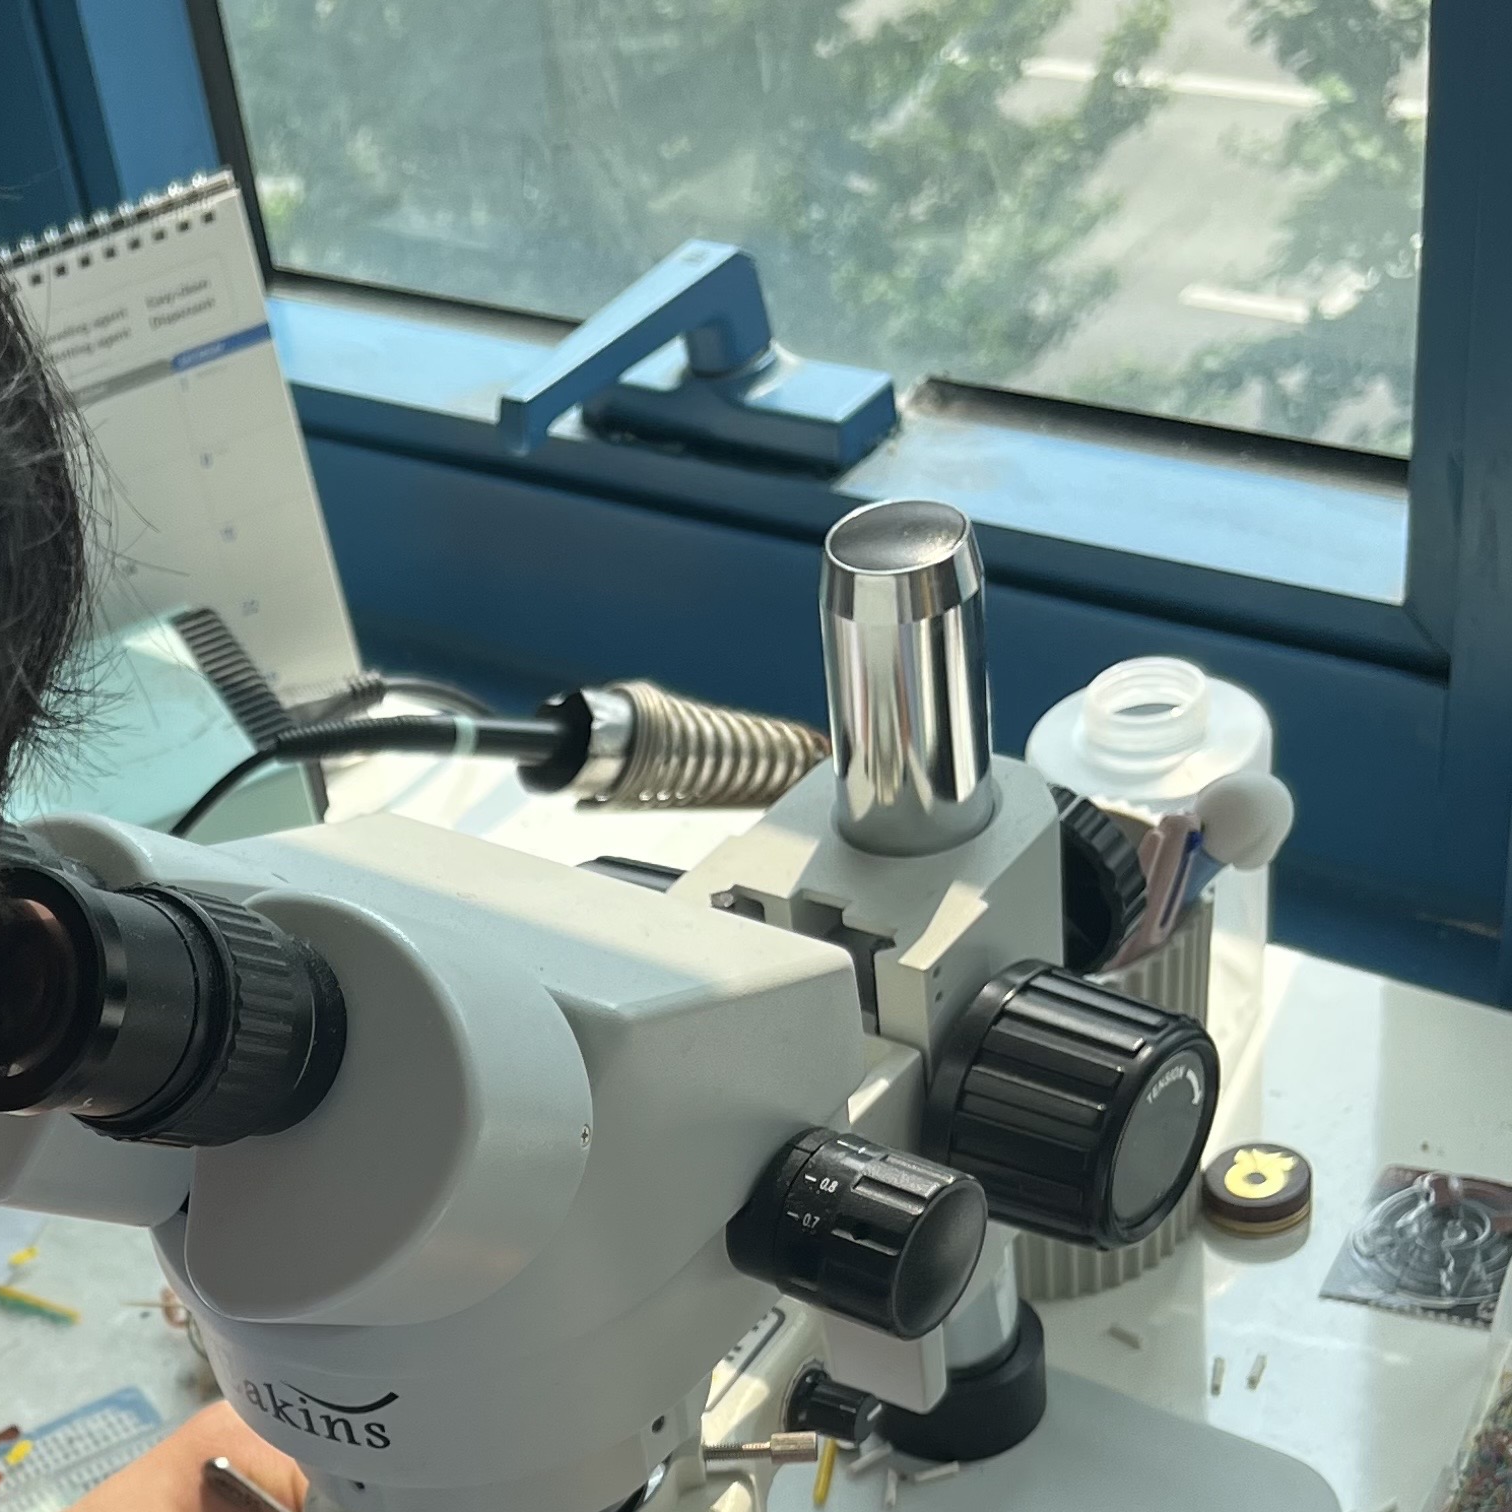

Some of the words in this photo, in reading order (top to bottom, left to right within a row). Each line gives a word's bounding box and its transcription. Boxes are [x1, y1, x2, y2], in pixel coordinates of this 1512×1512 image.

[1146, 1064, 1187, 1104] TENSION
[820, 1177, 838, 1193] 0.8
[803, 1213, 820, 1228] 0.7
[242, 1379, 391, 1449] akins
